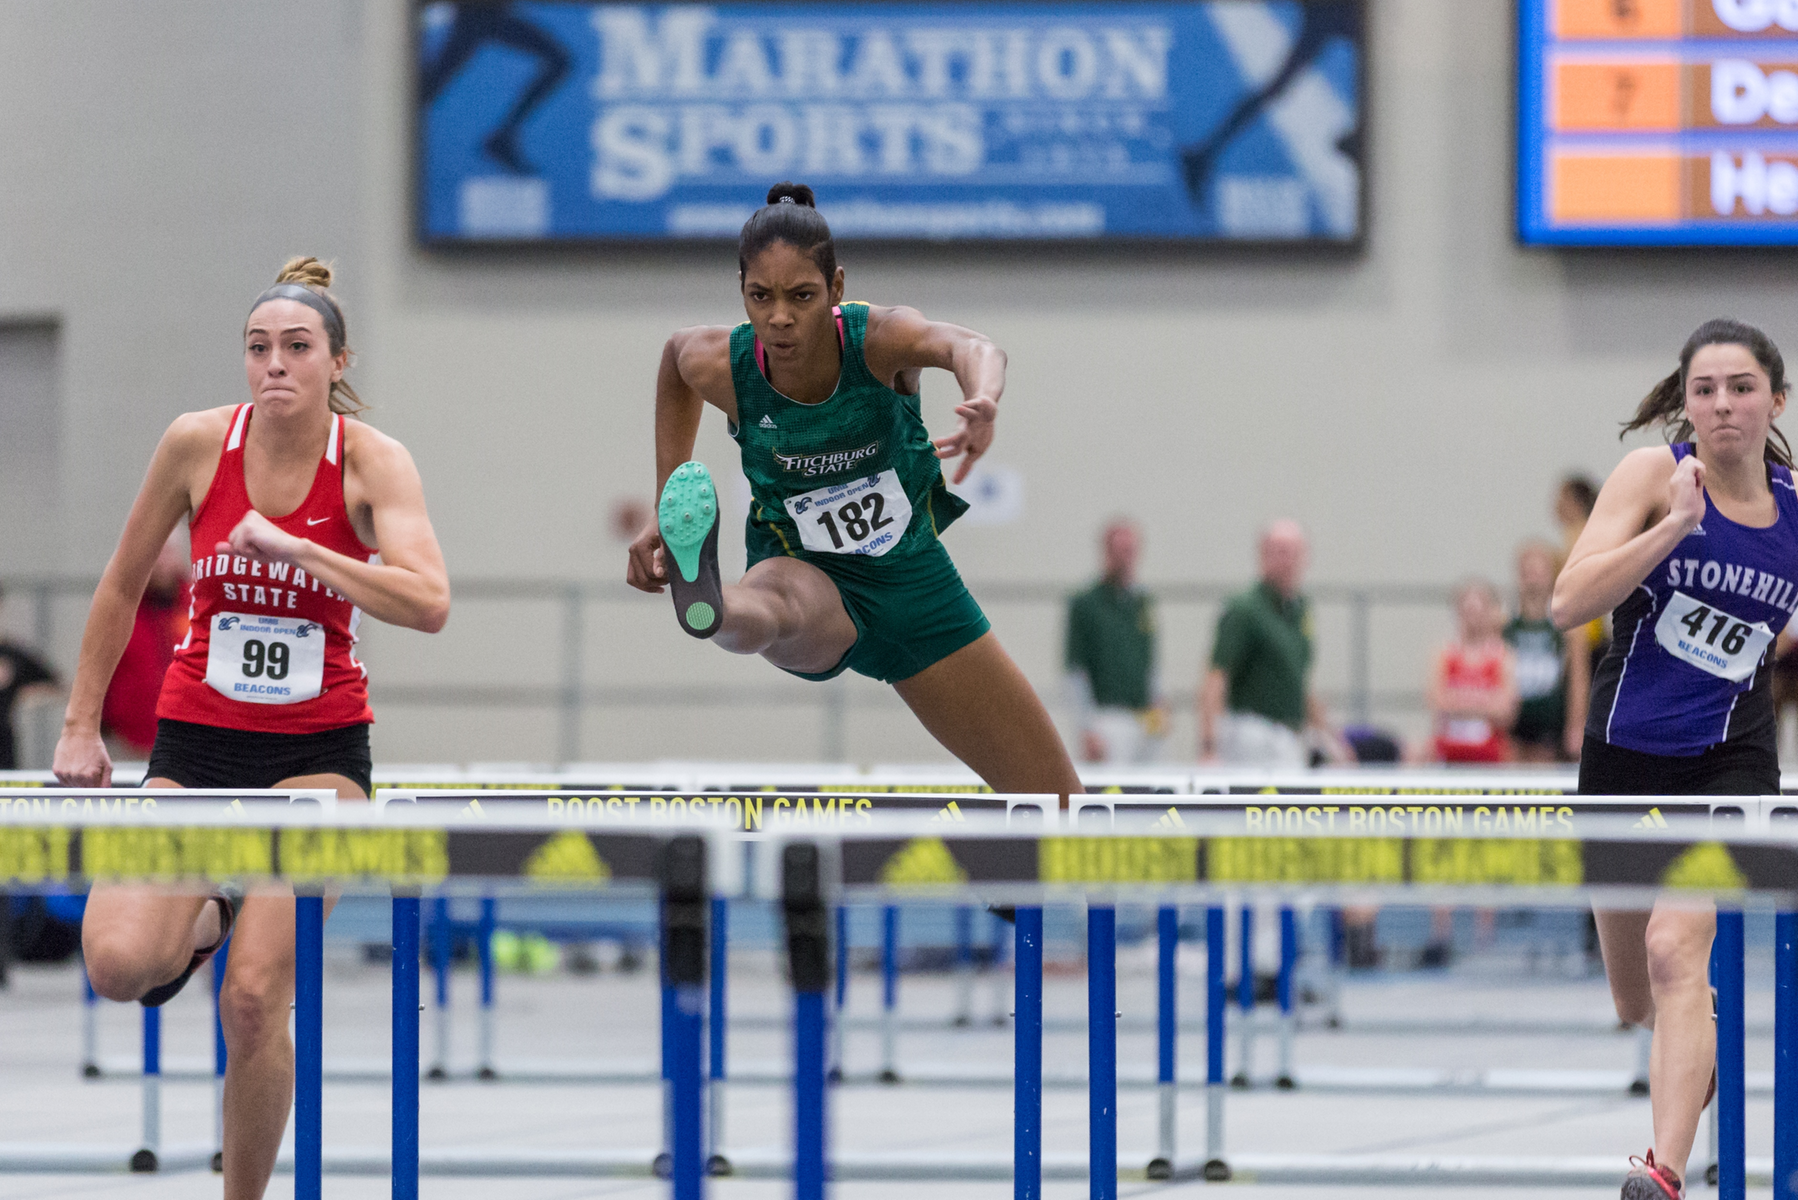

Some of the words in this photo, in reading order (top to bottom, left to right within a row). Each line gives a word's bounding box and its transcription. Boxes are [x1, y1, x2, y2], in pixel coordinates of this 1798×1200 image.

[596, 4, 1171, 100] MARATHON
[593, 104, 984, 199] SPORTS
[775, 444, 877, 470] FITCHBURG
[804, 461, 856, 476] STATE
[814, 493, 846, 507] INDOOR
[847, 482, 869, 496] OPEN
[816, 492, 894, 549] 182
[848, 531, 894, 554] ACONS
[192, 554, 345, 602] RIDGEWATE
[223, 582, 298, 609] STATE
[240, 624, 272, 633] INDOOR
[273, 628, 297, 636] OPEN
[1680, 605, 1753, 655] 416
[242, 639, 290, 681] 99
[1678, 639, 1729, 670] BEACONS
[233, 682, 291, 696] BEACONS
[546, 796, 641, 827] BOOST
[649, 796, 764, 830] BOSTON
[772, 797, 874, 830] GAMES
[1245, 806, 1340, 835] BOOST
[1349, 806, 1463, 835] BOSTON
[1473, 806, 1575, 836] GAMES
